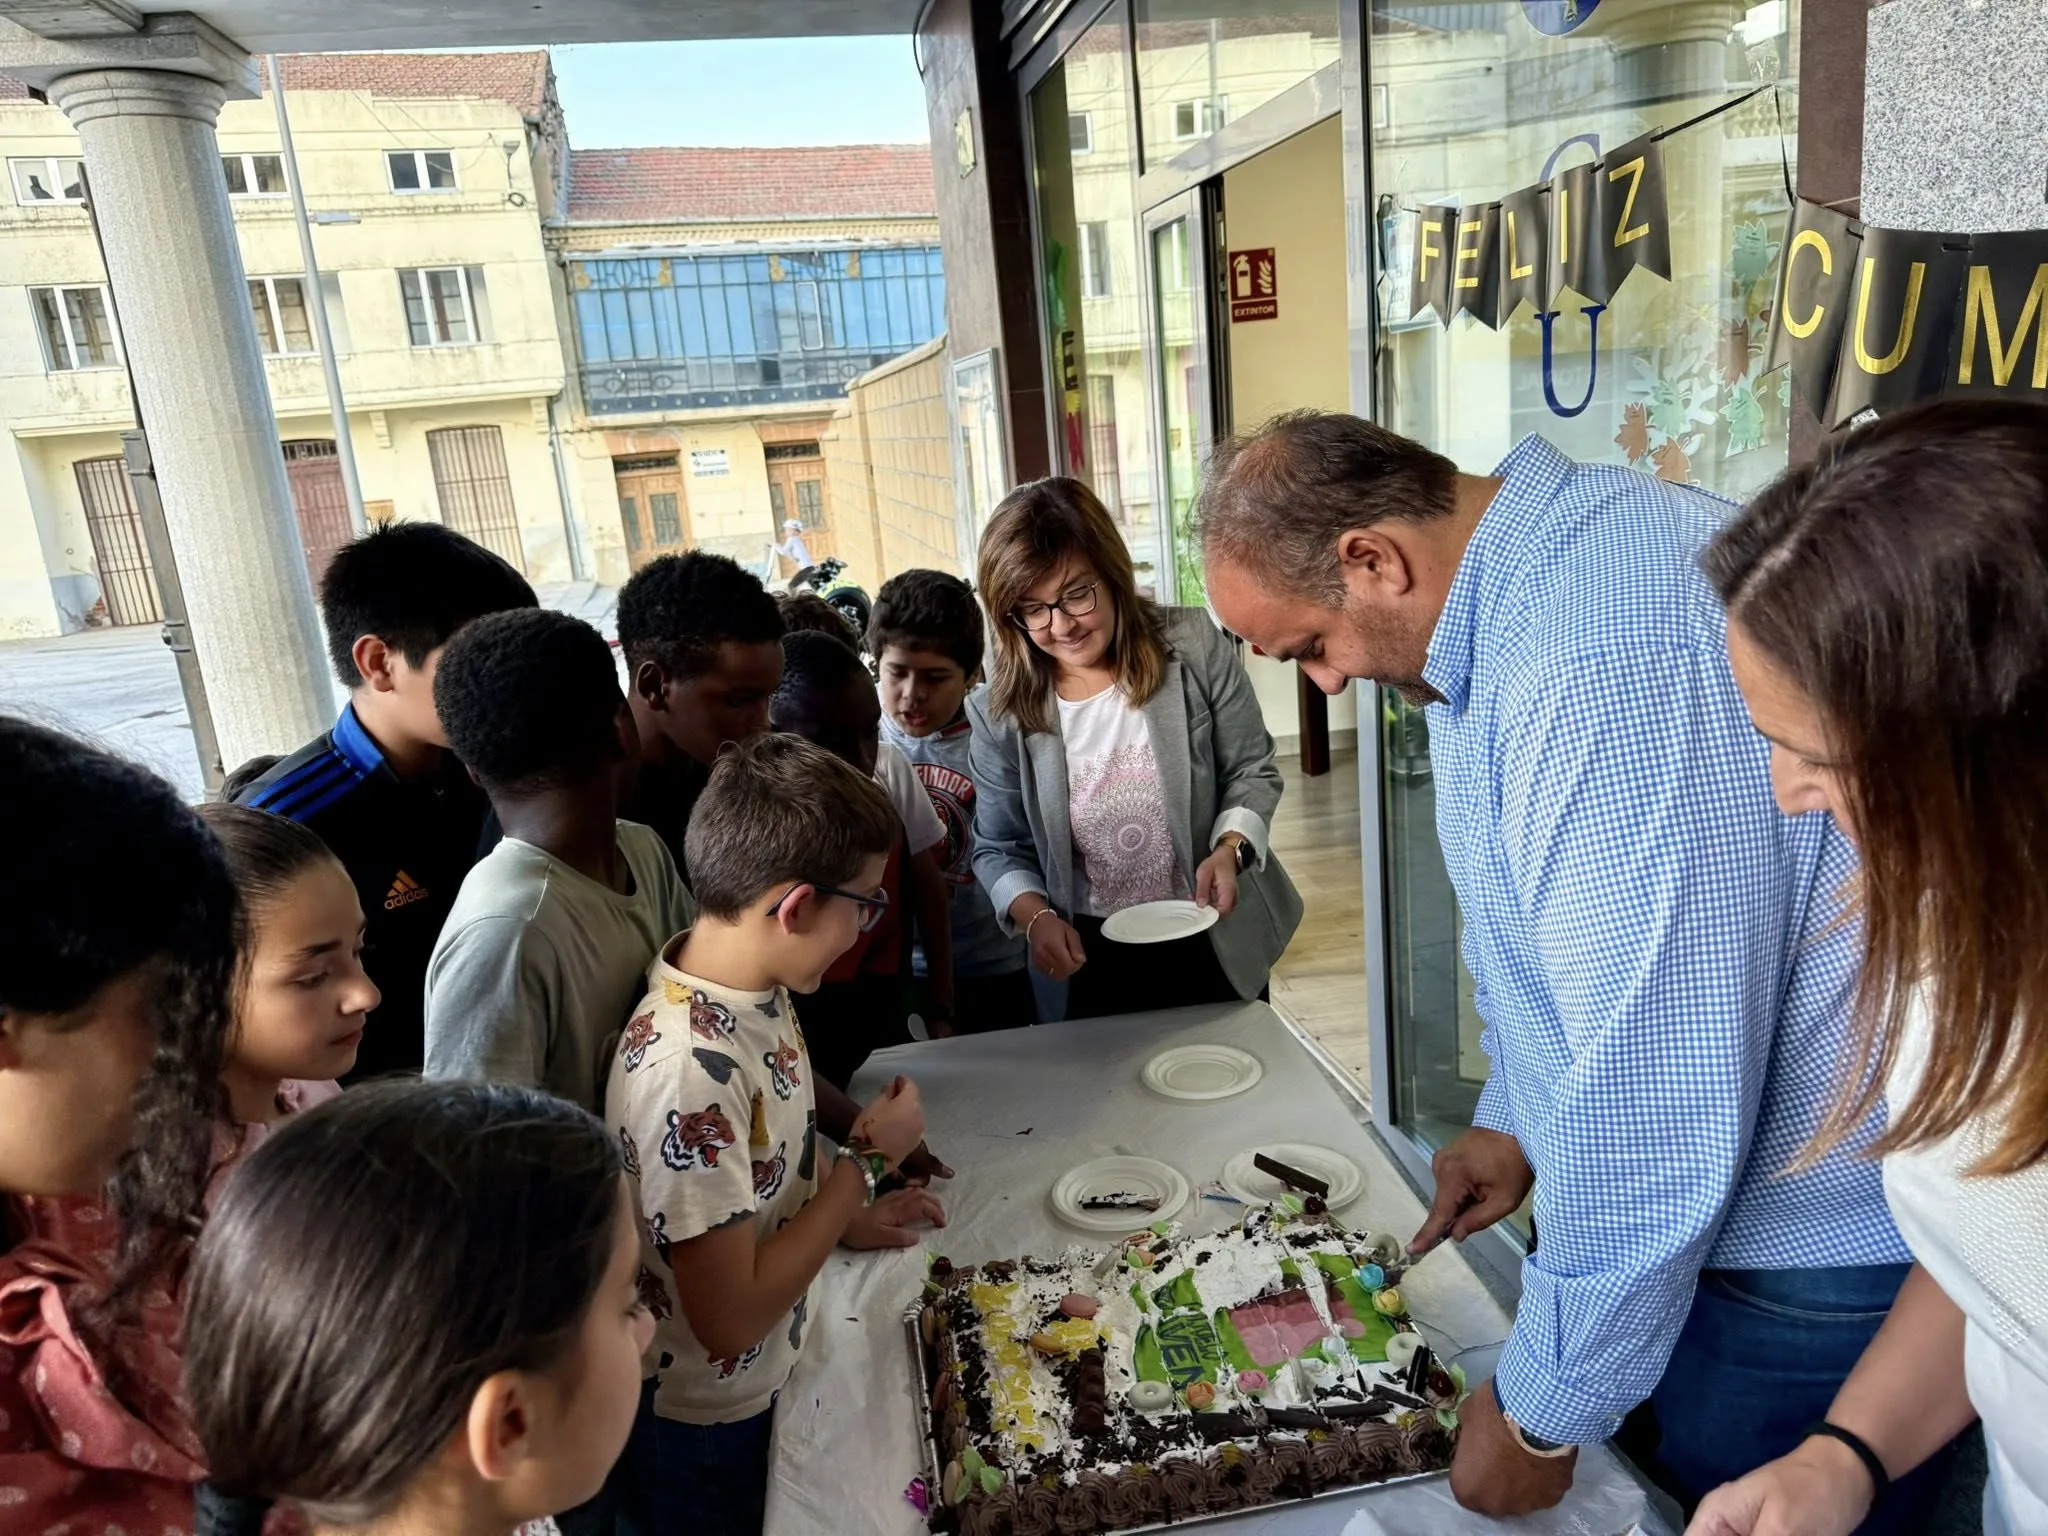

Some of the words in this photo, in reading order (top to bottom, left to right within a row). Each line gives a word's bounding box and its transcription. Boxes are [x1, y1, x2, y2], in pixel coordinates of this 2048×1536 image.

[1420, 156, 1650, 289] FELIZ
[1234, 304, 1276, 317] EXTINTOR
[1781, 229, 2048, 389] CUM
[384, 888, 428, 910] adidas
